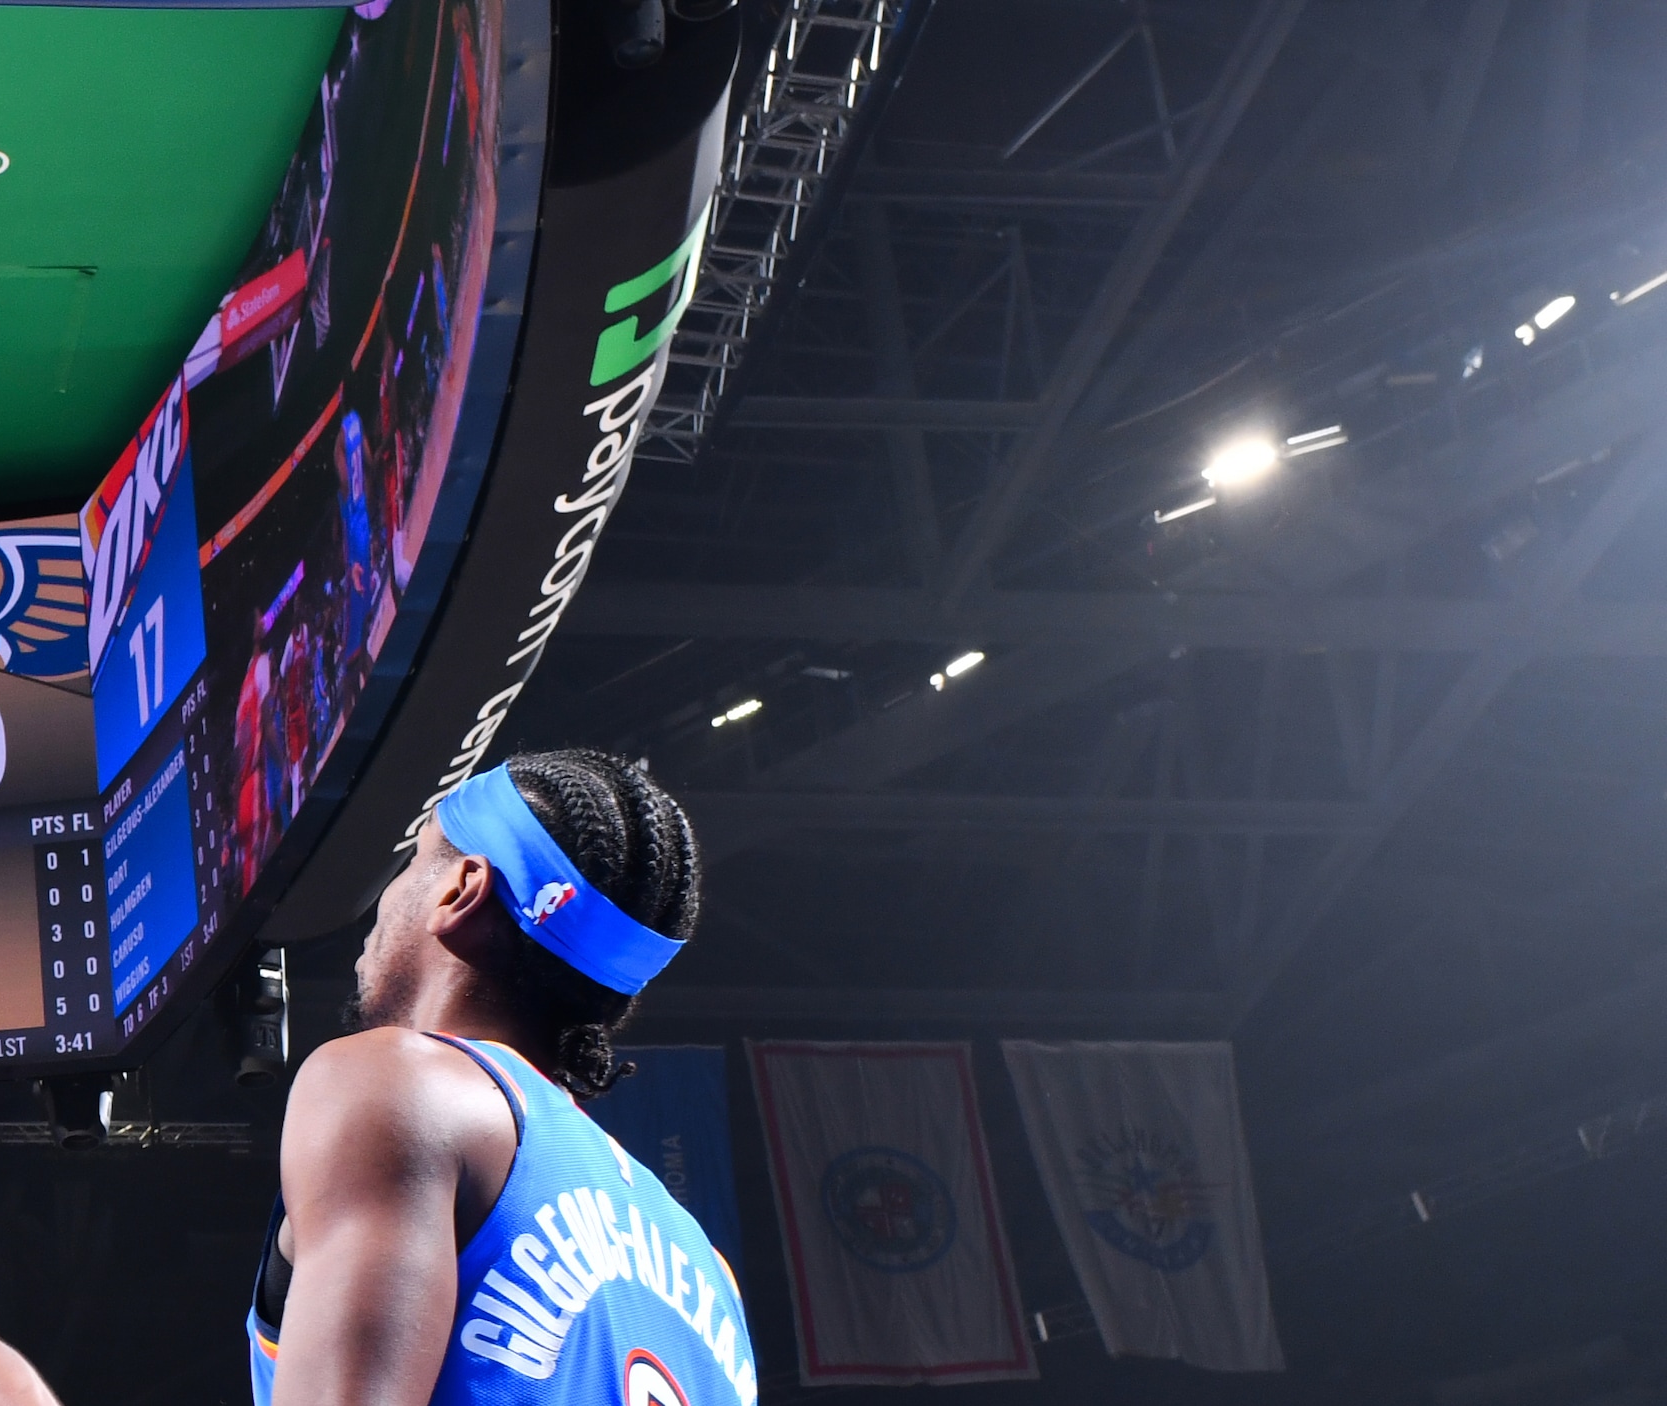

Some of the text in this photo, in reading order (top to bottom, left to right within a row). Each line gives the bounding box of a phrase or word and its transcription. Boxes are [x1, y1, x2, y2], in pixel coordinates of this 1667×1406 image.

[89, 381, 184, 666] OKC
[506, 364, 659, 666] paycom
[128, 594, 165, 729] 17
[181, 679, 207, 725] PTS FL
[103, 777, 133, 824] PLAYER
[31, 815, 65, 836] PTS
[72, 812, 94, 832] FL
[47, 851, 58, 871] 0
[82, 848, 90, 866] 1
[49, 887, 60, 906] 0
[81, 884, 93, 903] 0
[51, 924, 63, 943] 3
[83, 920, 95, 939] 0
[53, 960, 65, 979] 0
[86, 956, 98, 975] 0
[55, 997, 67, 1016] 5
[88, 993, 100, 1012] 0
[54, 1031, 93, 1054] 3:41
